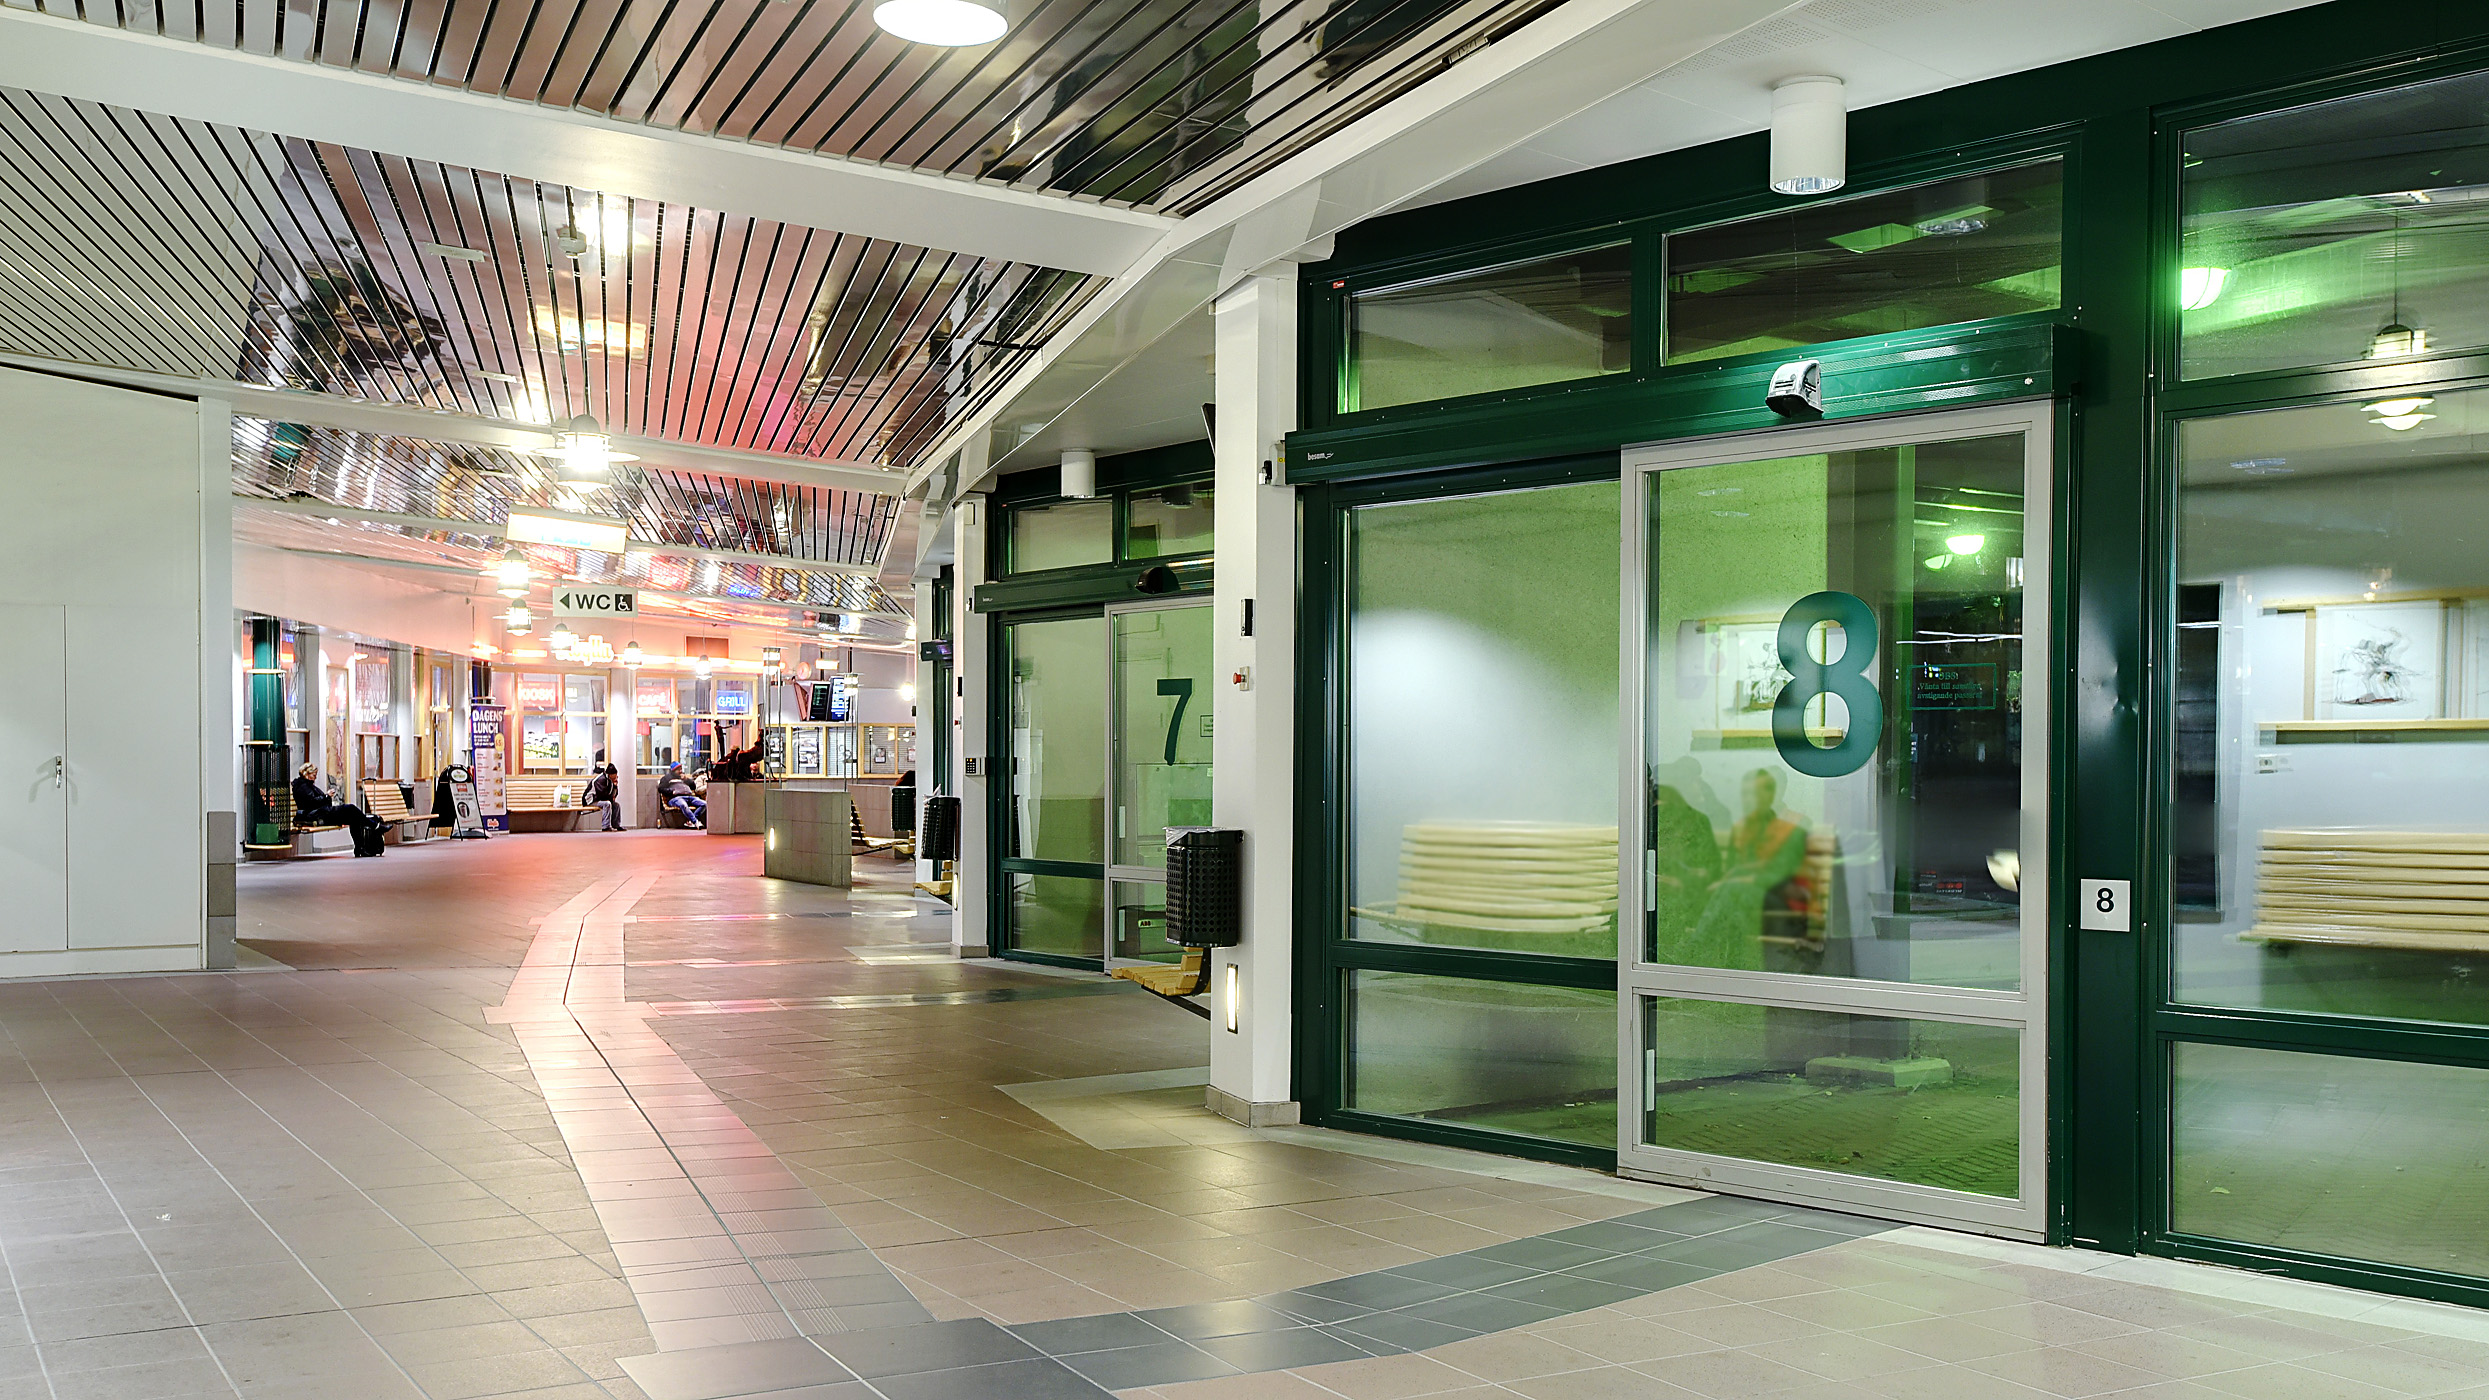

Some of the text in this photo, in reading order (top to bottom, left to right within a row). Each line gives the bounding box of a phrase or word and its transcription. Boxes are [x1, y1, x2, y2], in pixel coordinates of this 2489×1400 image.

[575, 593, 611, 610] WC
[1771, 590, 1884, 778] 8
[718, 696, 746, 707] GRILL
[472, 709, 503, 721] DAGENS
[1156, 678, 1193, 763] 7
[473, 721, 498, 734] LUNCH
[2096, 887, 2115, 913] 8
